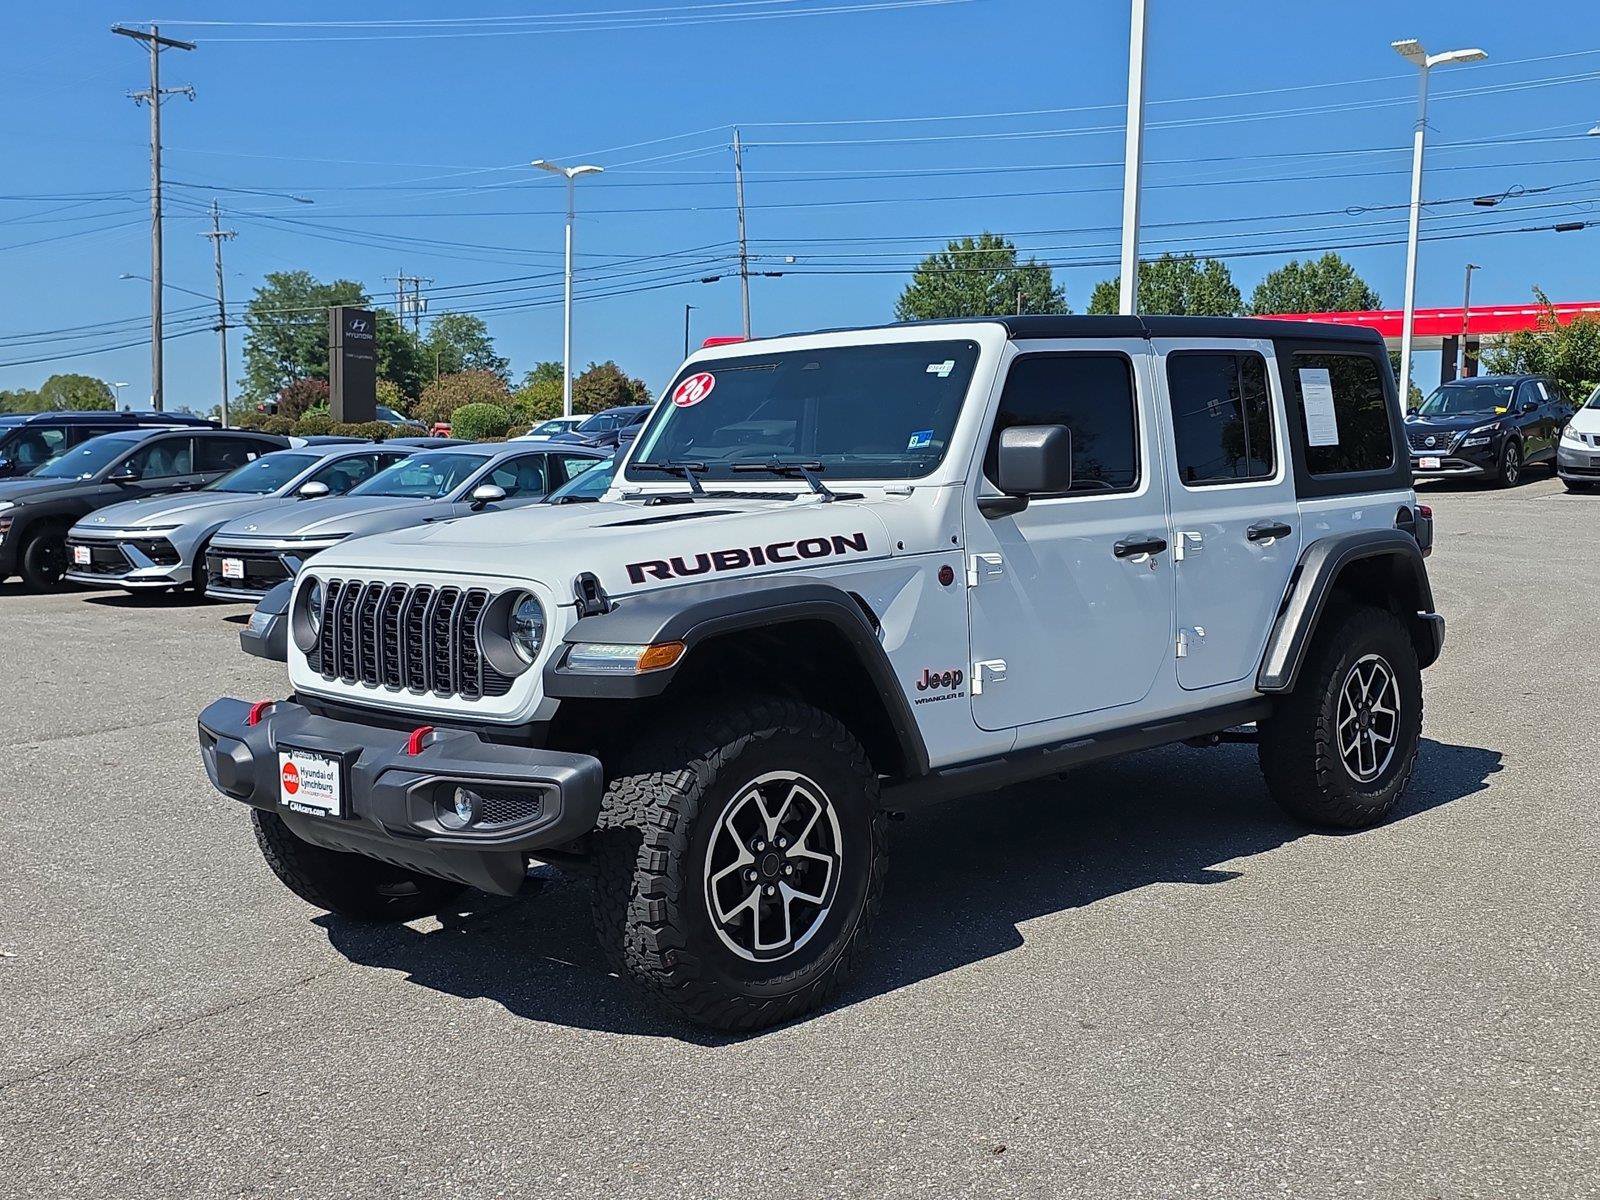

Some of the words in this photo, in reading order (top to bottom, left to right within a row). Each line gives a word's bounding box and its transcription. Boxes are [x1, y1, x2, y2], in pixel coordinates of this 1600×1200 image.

[345, 332, 373, 340] HYUNDAI
[675, 376, 709, 403] 26
[625, 532, 869, 585] RUBICON
[915, 669, 963, 691] Jeep
[914, 692, 957, 705] WRANGLER
[301, 767, 327, 780] Hyundai
[327, 772, 334, 781] of
[301, 778, 333, 794] Lynchburg
[290, 802, 326, 817] CMAcars.com
